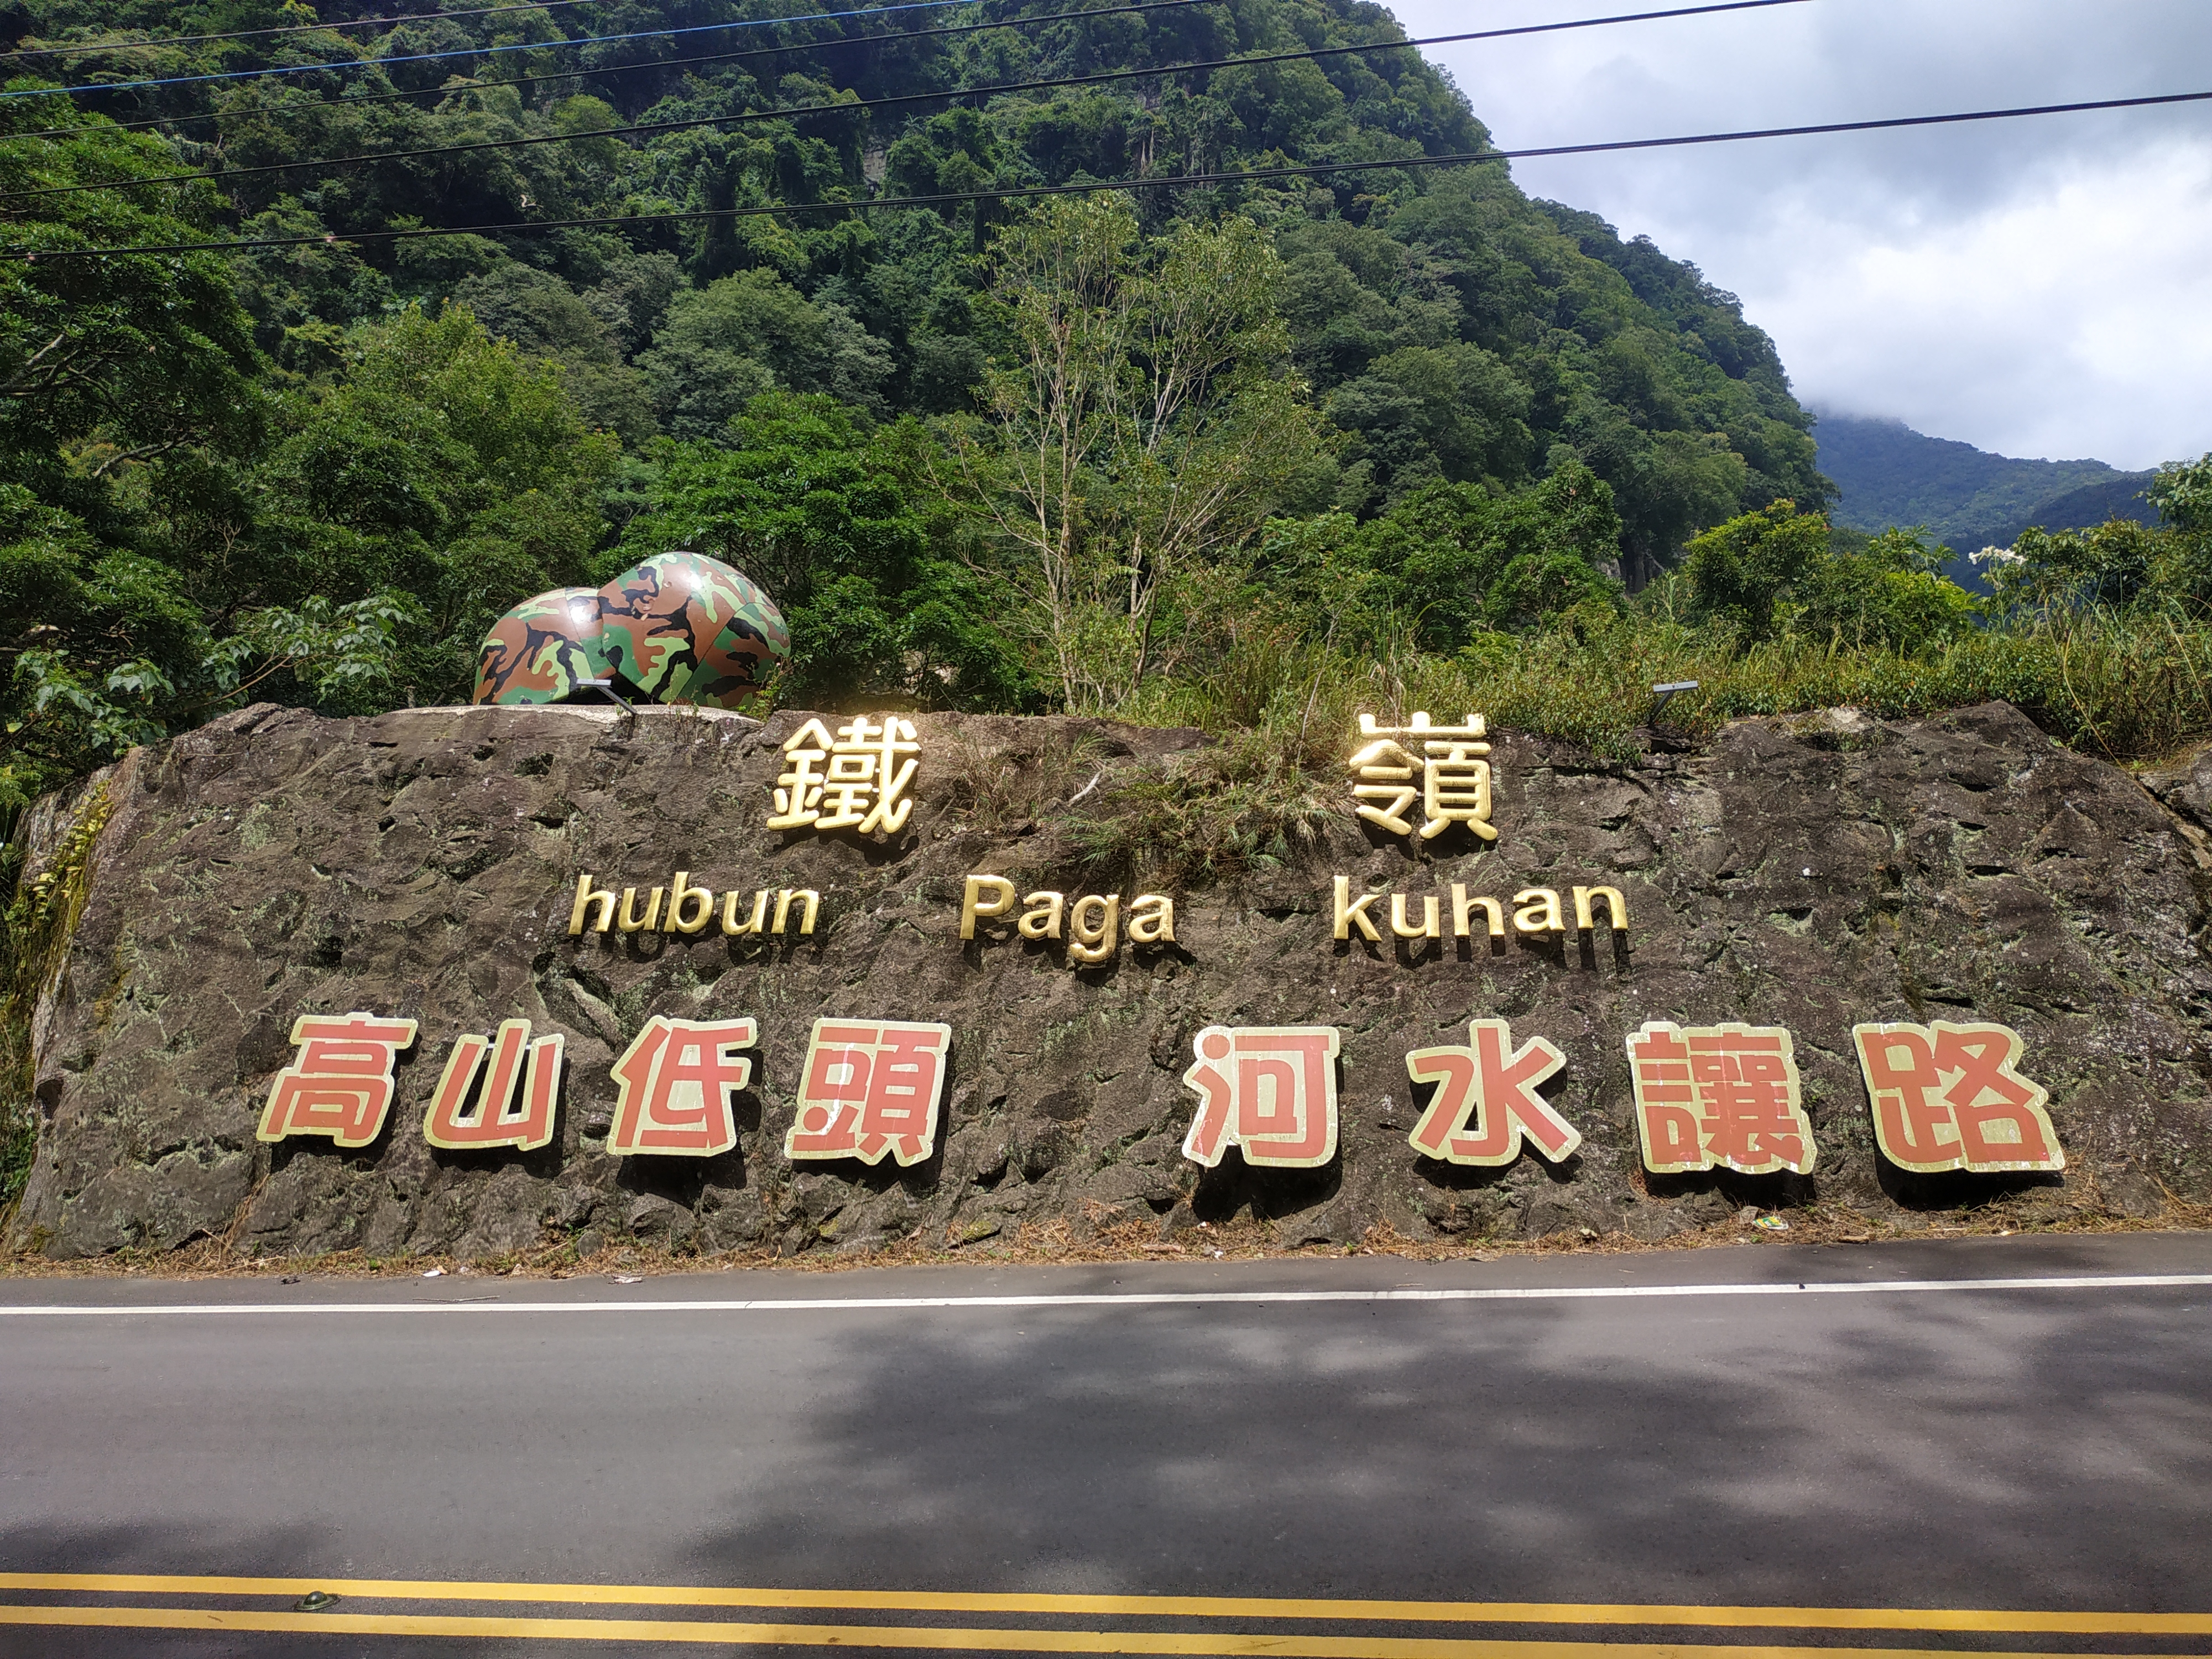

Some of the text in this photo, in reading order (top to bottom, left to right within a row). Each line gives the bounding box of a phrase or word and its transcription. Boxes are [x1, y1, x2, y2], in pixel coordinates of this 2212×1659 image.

[568, 872, 1629, 963] hubun Paga kuhan
[255, 1011, 2067, 1176] 高山低頭 河水讓路
